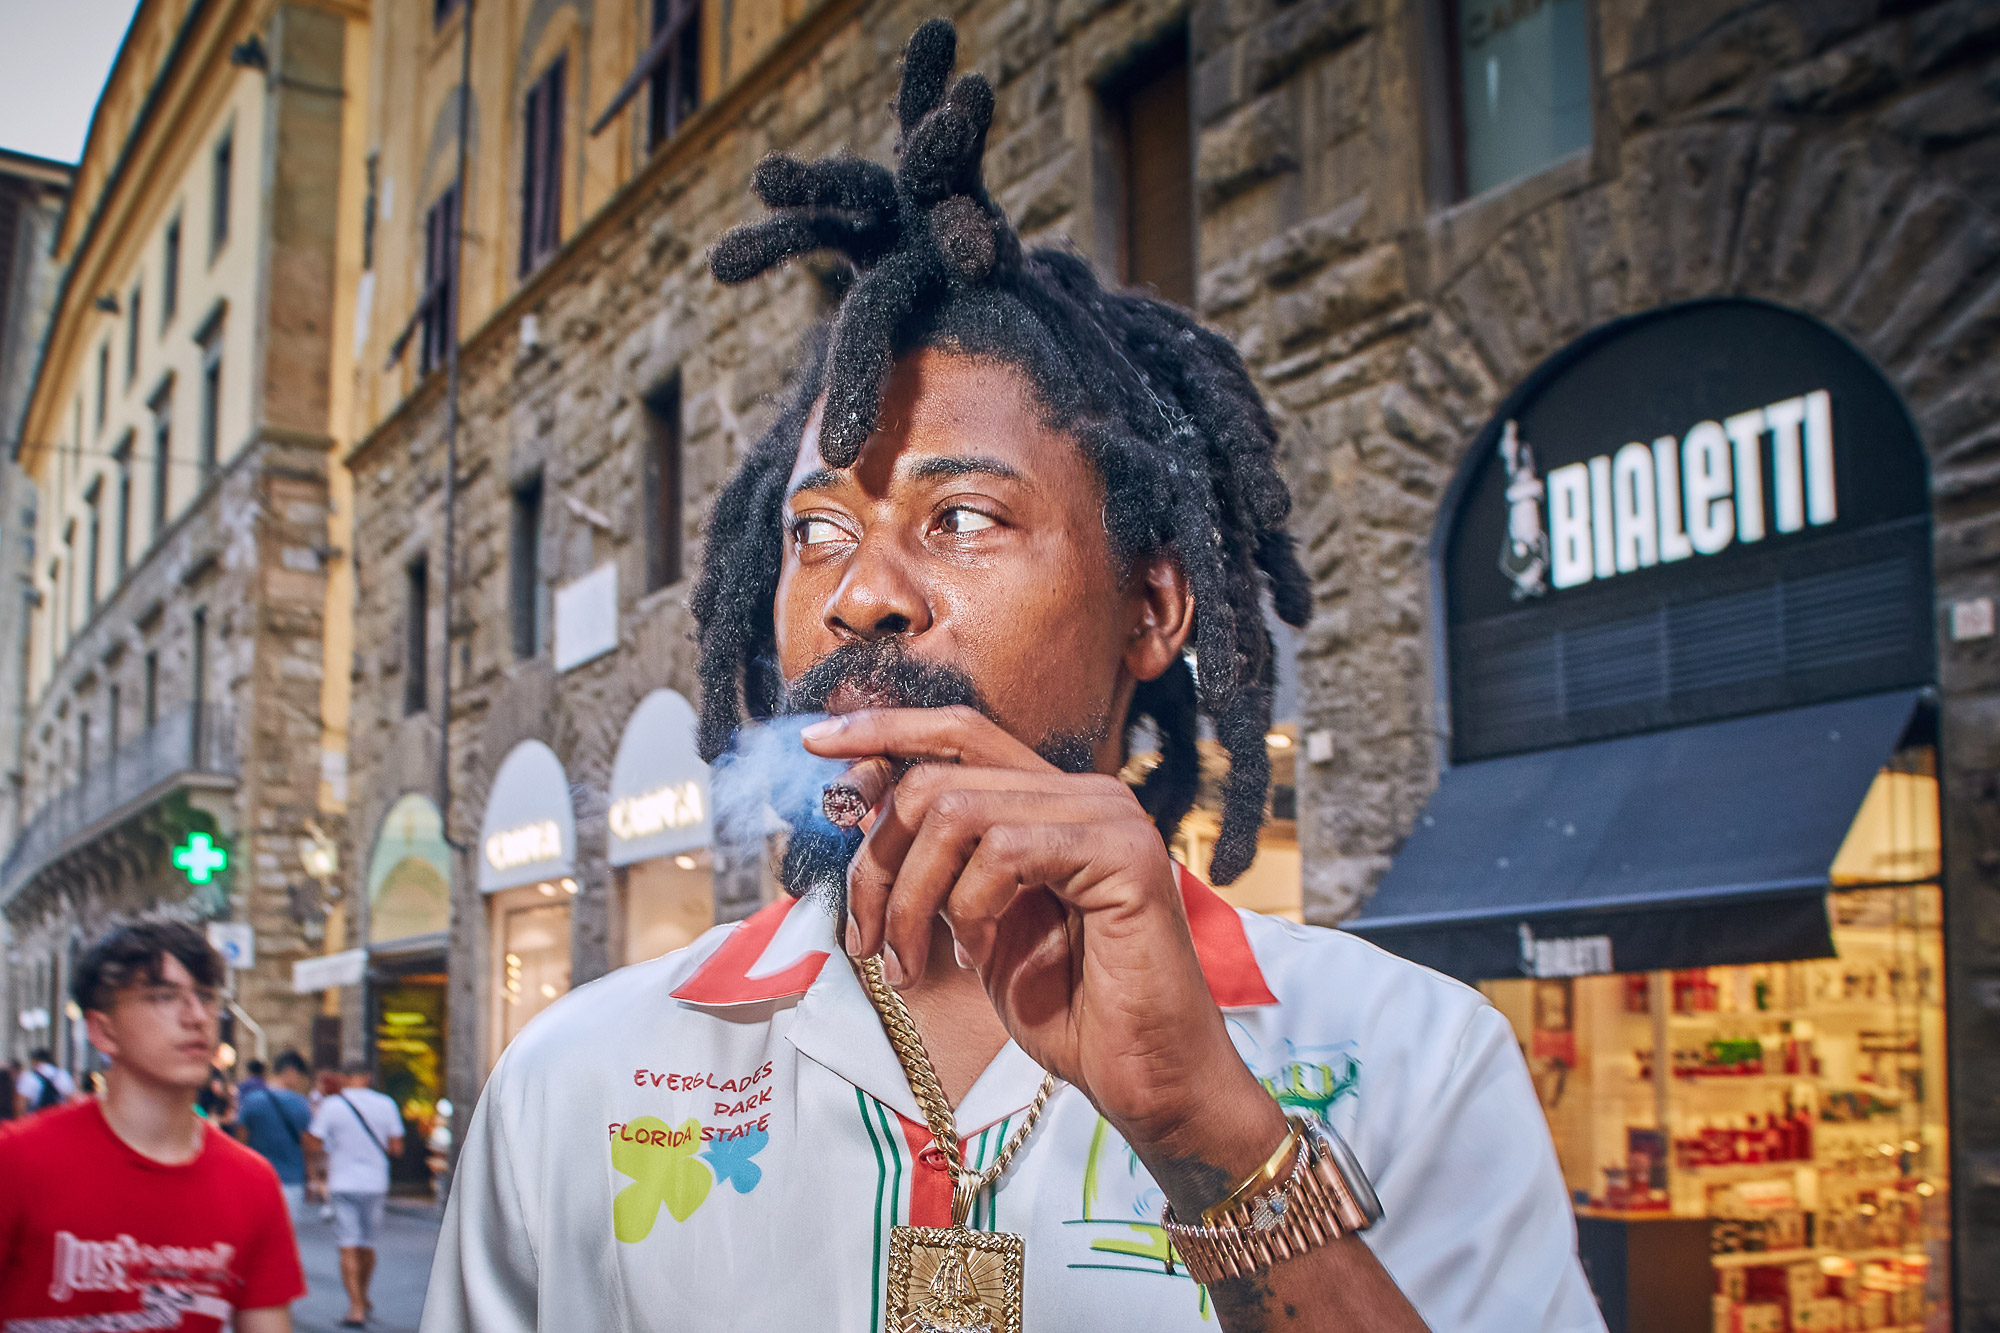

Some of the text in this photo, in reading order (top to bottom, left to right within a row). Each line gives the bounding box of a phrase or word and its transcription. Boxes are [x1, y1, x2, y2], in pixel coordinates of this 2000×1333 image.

[634, 1060, 774, 1092] EVERGLADES
[713, 1086, 773, 1117] PARK
[608, 1113, 771, 1147] FLORIDA STATE
